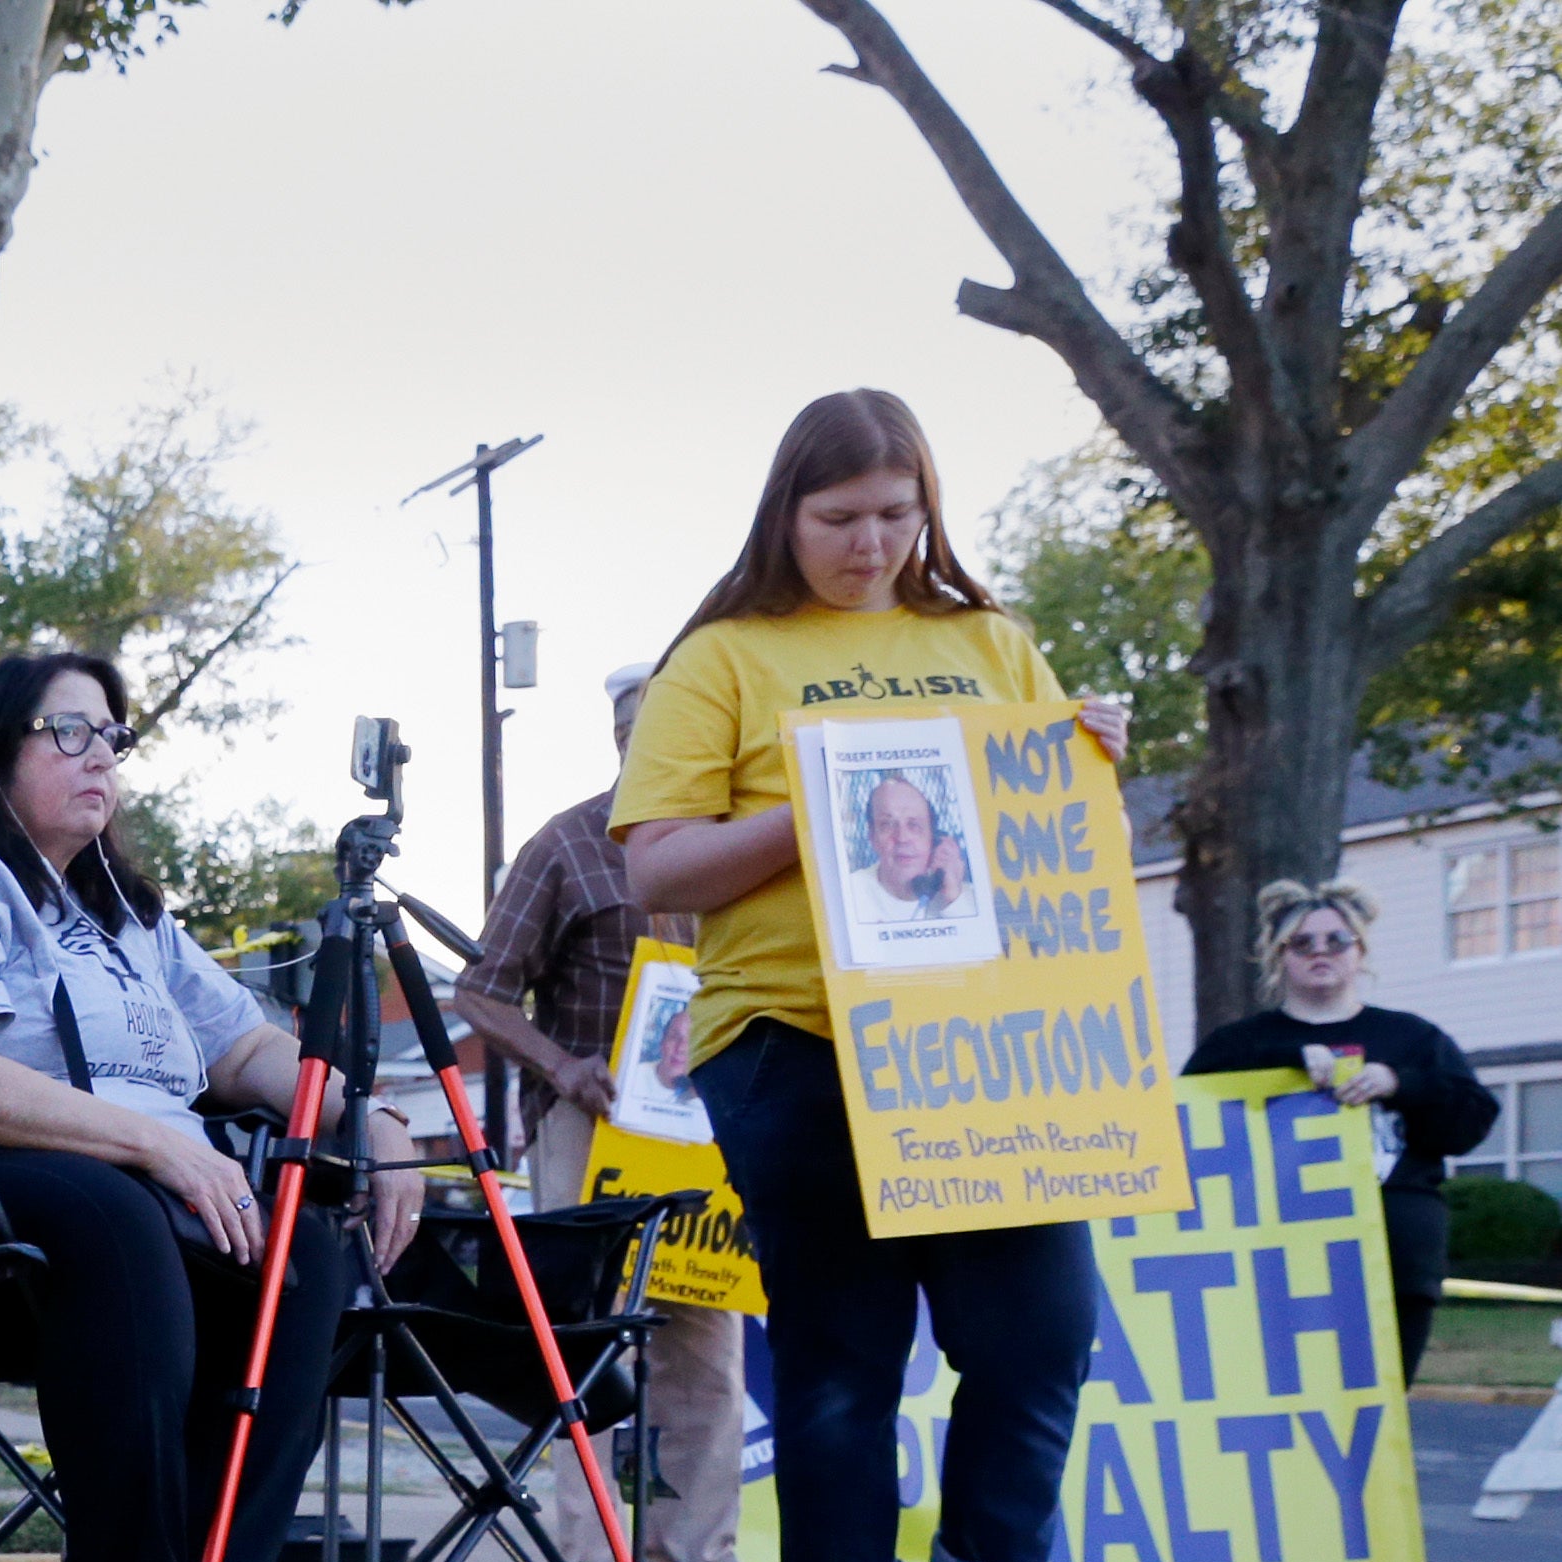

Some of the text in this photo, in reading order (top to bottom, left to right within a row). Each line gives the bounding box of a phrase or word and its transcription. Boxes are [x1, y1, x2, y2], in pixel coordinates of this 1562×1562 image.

[801, 668, 983, 706] ABOLISH
[984, 718, 1076, 796] NOT
[996, 801, 1095, 882] ONE
[993, 886, 1122, 960] MORE
[140, 1039, 166, 1067] THE
[891, 1120, 1138, 1162] Texas Death Penalty
[1111, 1089, 1356, 1238] HE
[878, 1164, 1162, 1213] ABOLITION MOVEMENT
